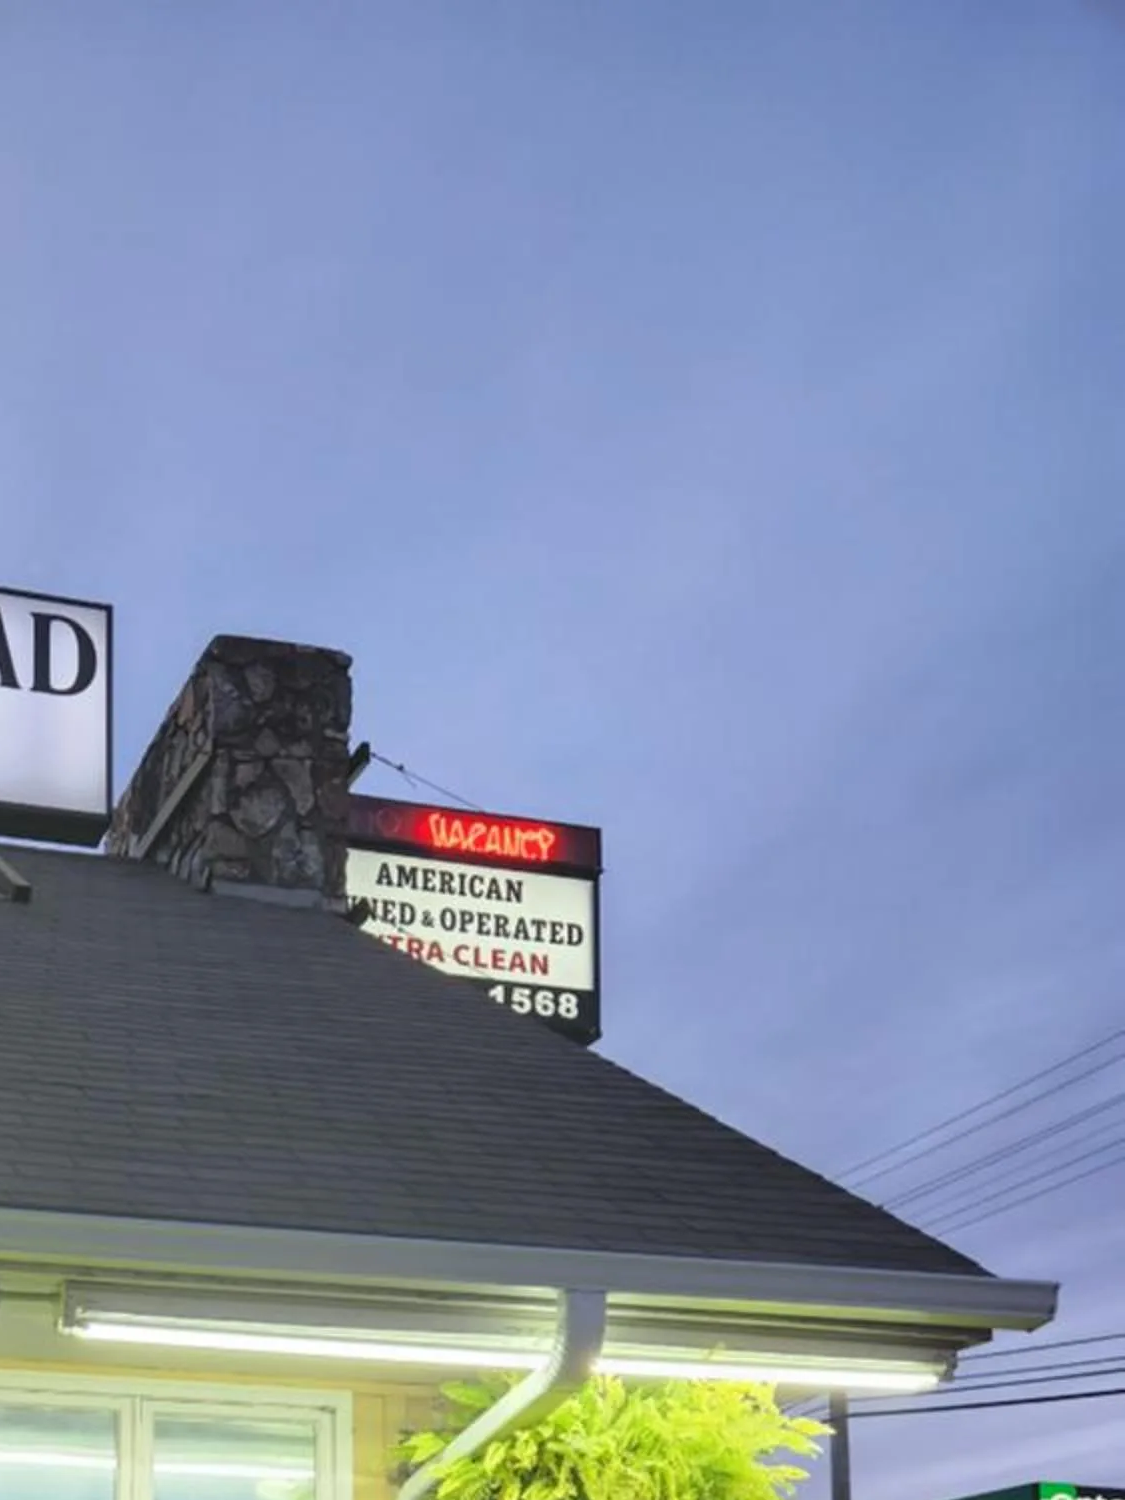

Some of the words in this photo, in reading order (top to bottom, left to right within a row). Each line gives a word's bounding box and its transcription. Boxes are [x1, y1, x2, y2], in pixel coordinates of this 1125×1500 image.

[428, 812, 556, 861] VACANCY
[375, 862, 524, 903] AMERICAN
[421, 910, 434, 928] &
[439, 907, 584, 947] OPERATED
[378, 933, 445, 962] TRA
[453, 944, 550, 976] CLEAN
[488, 985, 579, 1019] 1568
